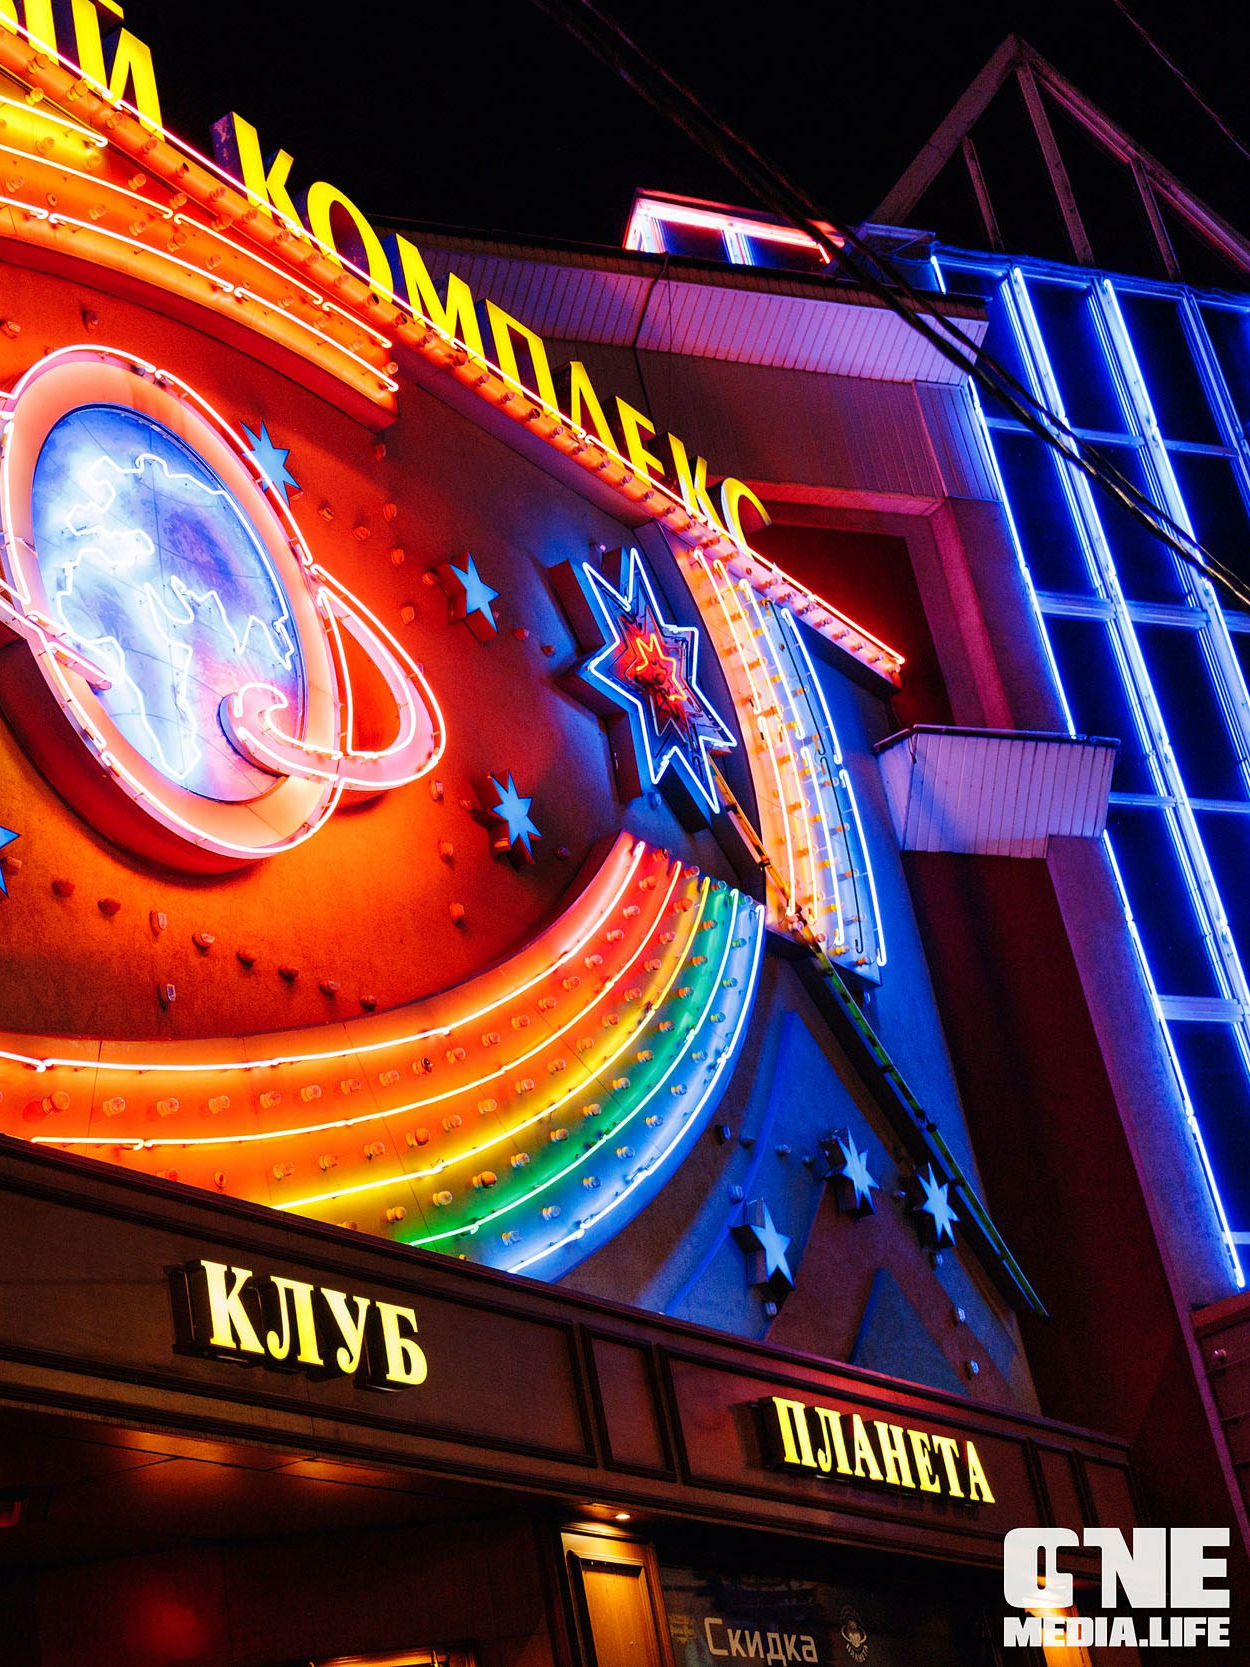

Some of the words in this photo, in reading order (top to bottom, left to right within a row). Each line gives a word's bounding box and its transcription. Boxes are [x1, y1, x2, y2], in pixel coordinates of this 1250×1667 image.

[232, 111, 772, 560] КОМПЛЕКС
[200, 1260, 428, 1385] КЛУБ
[772, 1396, 996, 1503] ПЛАНЕТА
[703, 1616, 818, 1667] Скидка
